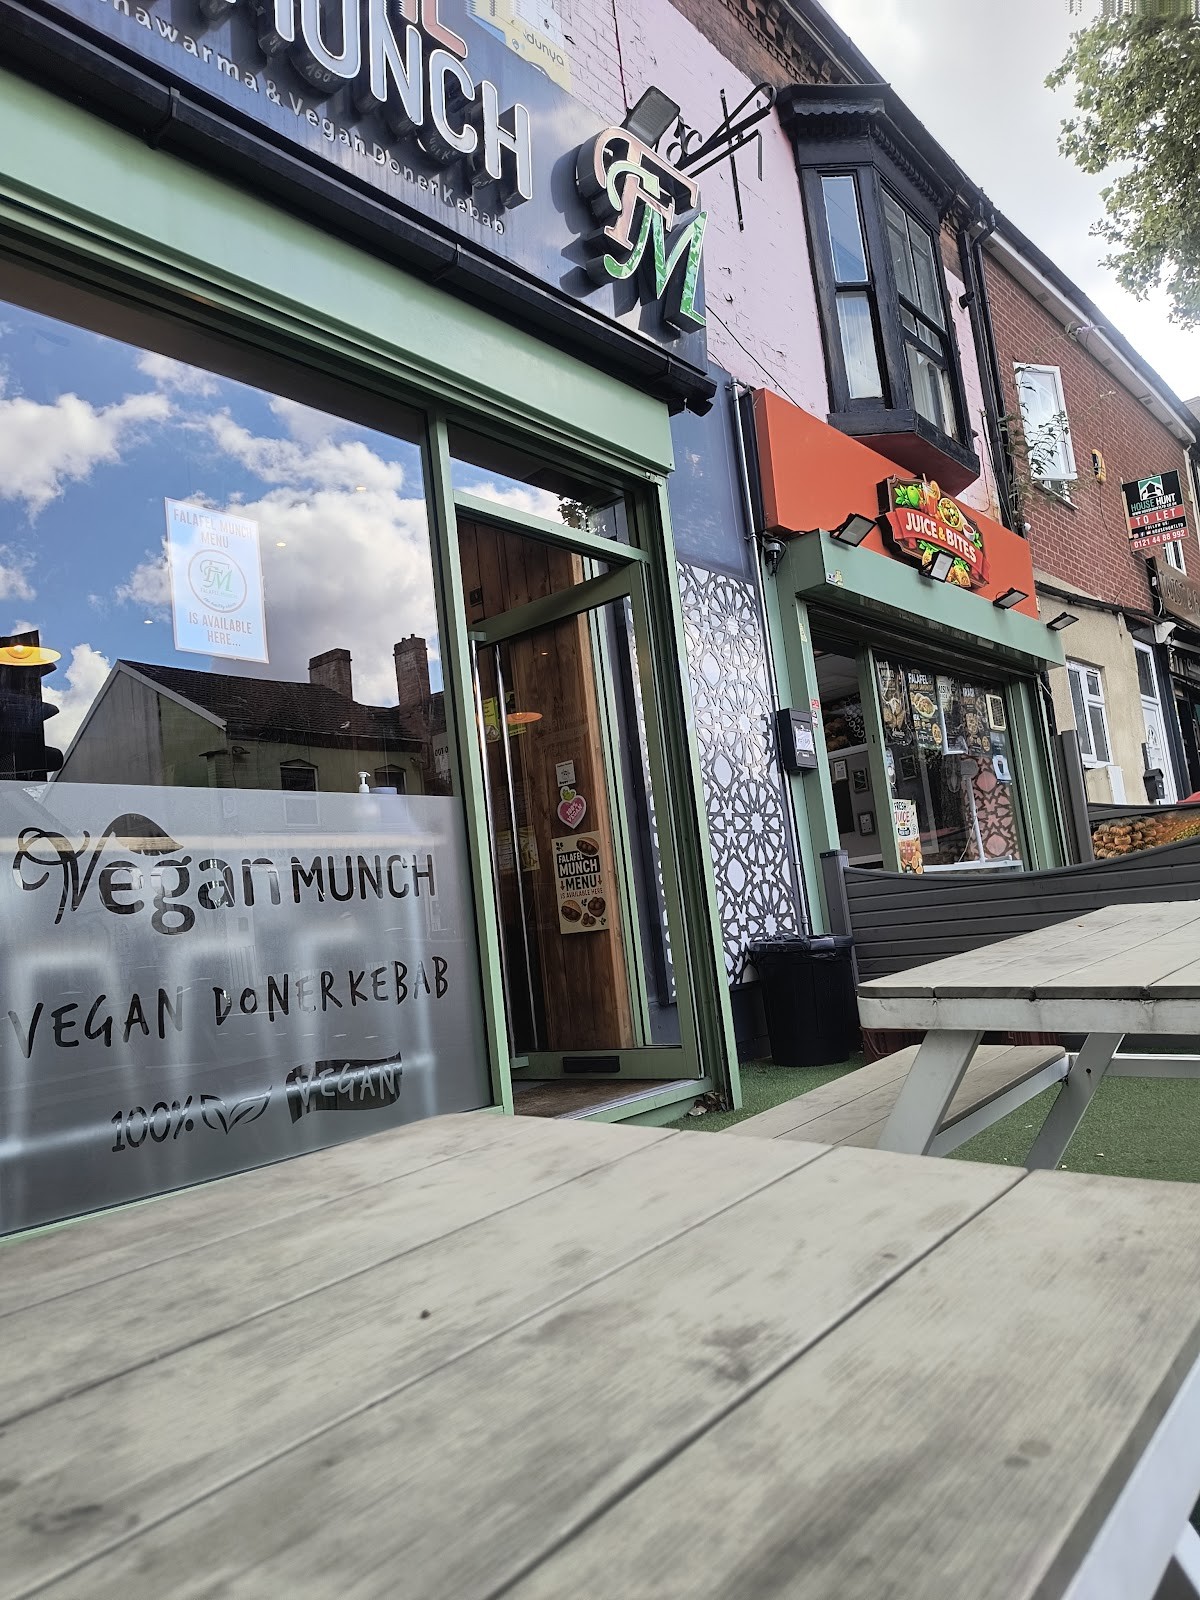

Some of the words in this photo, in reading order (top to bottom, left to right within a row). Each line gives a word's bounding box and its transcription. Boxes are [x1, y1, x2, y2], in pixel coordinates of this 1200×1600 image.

[100, 0, 259, 93] hawarma
[266, 80, 283, 107] &
[288, 91, 366, 156] Vegan
[372, 142, 439, 195] Doner
[443, 184, 505, 235] Kebab
[1131, 499, 1155, 512] HOUSE
[1155, 493, 1176, 507] HUNT
[173, 508, 217, 531] FALAFEL
[219, 520, 253, 539] MUNCH
[1136, 515, 1149, 526] TO
[1156, 508, 1176, 520] LET
[201, 531, 229, 549] MENU
[906, 512, 938, 539] JUICE
[938, 526, 946, 541] &
[945, 528, 976, 563] BITES
[1133, 538, 1150, 548] 0121
[1152, 535, 1160, 544] 44
[1162, 533, 1171, 541] 88
[1173, 529, 1185, 538] 992
[189, 611, 198, 625] IS
[202, 614, 253, 635] AVAILABLE
[907, 672, 929, 685] FALAFEL
[567, 804, 583, 823] VEGAN
[894, 801, 906, 810] FRESH
[895, 811, 910, 824] JUICE
[558, 852, 584, 864] FALAFEL
[558, 858, 598, 877] MUNCH
[12, 814, 281, 935] Vegan
[291, 854, 435, 903] MUNCH
[565, 874, 597, 892] MENU
[565, 889, 591, 899] AVAILABLE
[591, 887, 603, 896] HERE
[8, 985, 183, 1058] VEGAN
[213, 970, 343, 1026] DONER
[349, 956, 448, 1005] KEBAB
[111, 1095, 194, 1152] 100%
[296, 1062, 397, 1108] VEGAN
